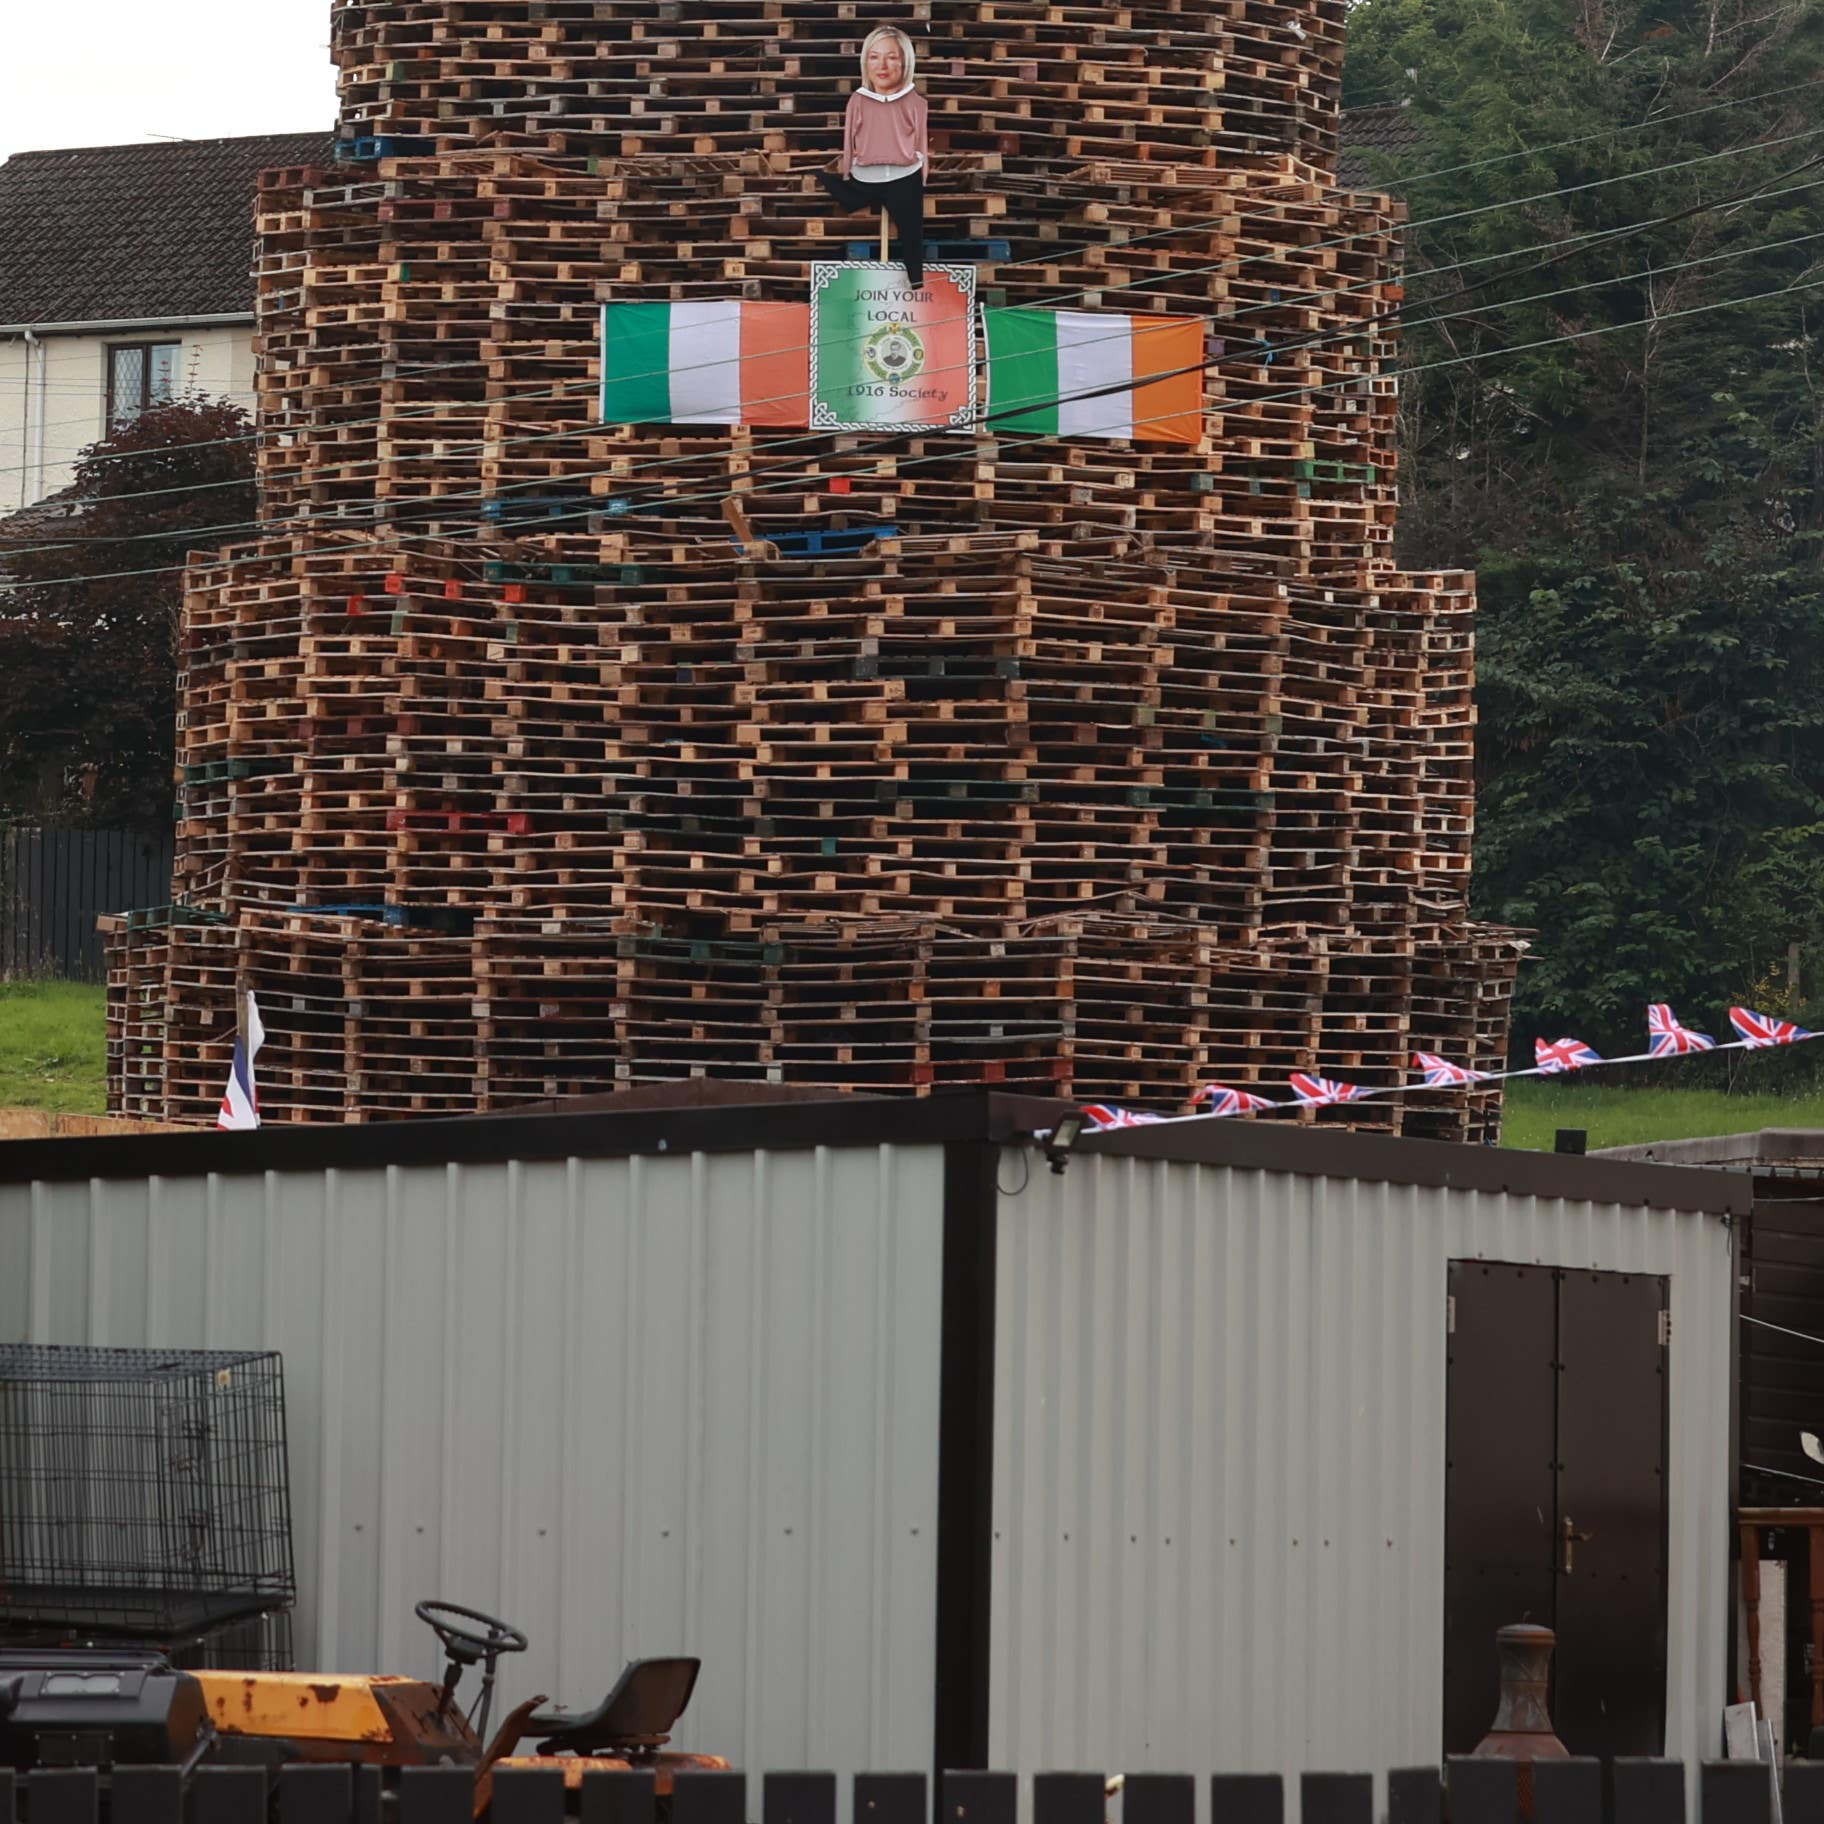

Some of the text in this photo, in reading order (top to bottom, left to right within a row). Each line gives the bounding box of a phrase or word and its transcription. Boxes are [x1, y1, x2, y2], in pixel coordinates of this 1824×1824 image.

[854, 289, 933, 303] JOIN YOUR
[867, 310, 917, 323] LOCAL
[848, 385, 948, 401] 1916 Society
